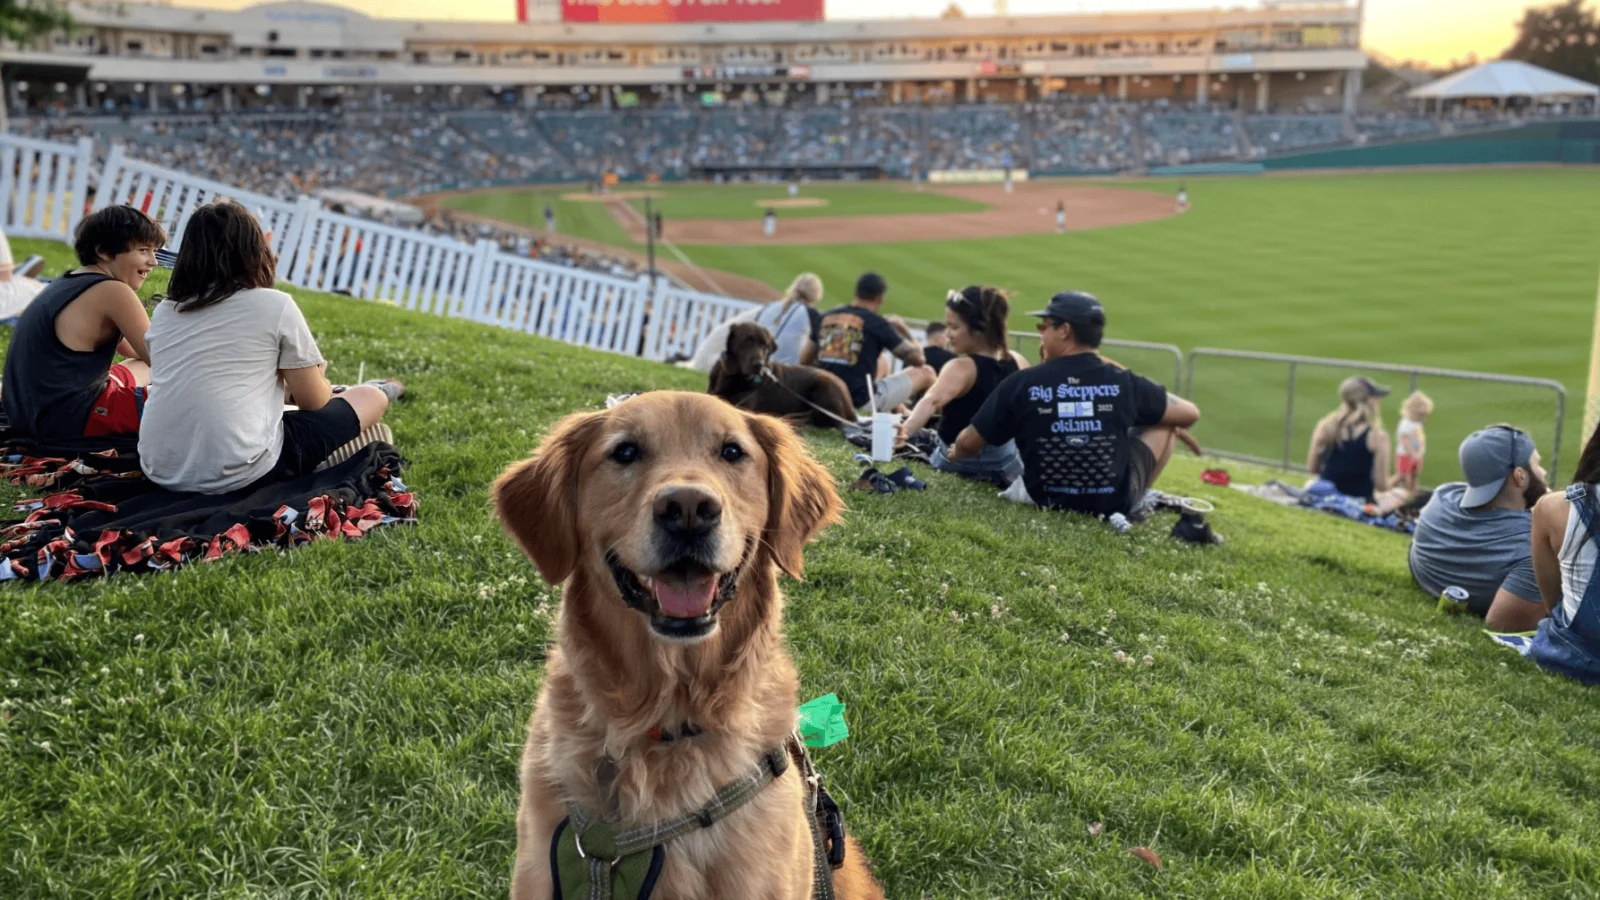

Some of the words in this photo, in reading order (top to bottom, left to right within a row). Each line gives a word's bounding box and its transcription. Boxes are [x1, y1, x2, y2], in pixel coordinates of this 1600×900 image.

[1028, 385, 1053, 402] Big
[1056, 383, 1120, 401] Steppers
[1098, 404, 1113, 412] 2022
